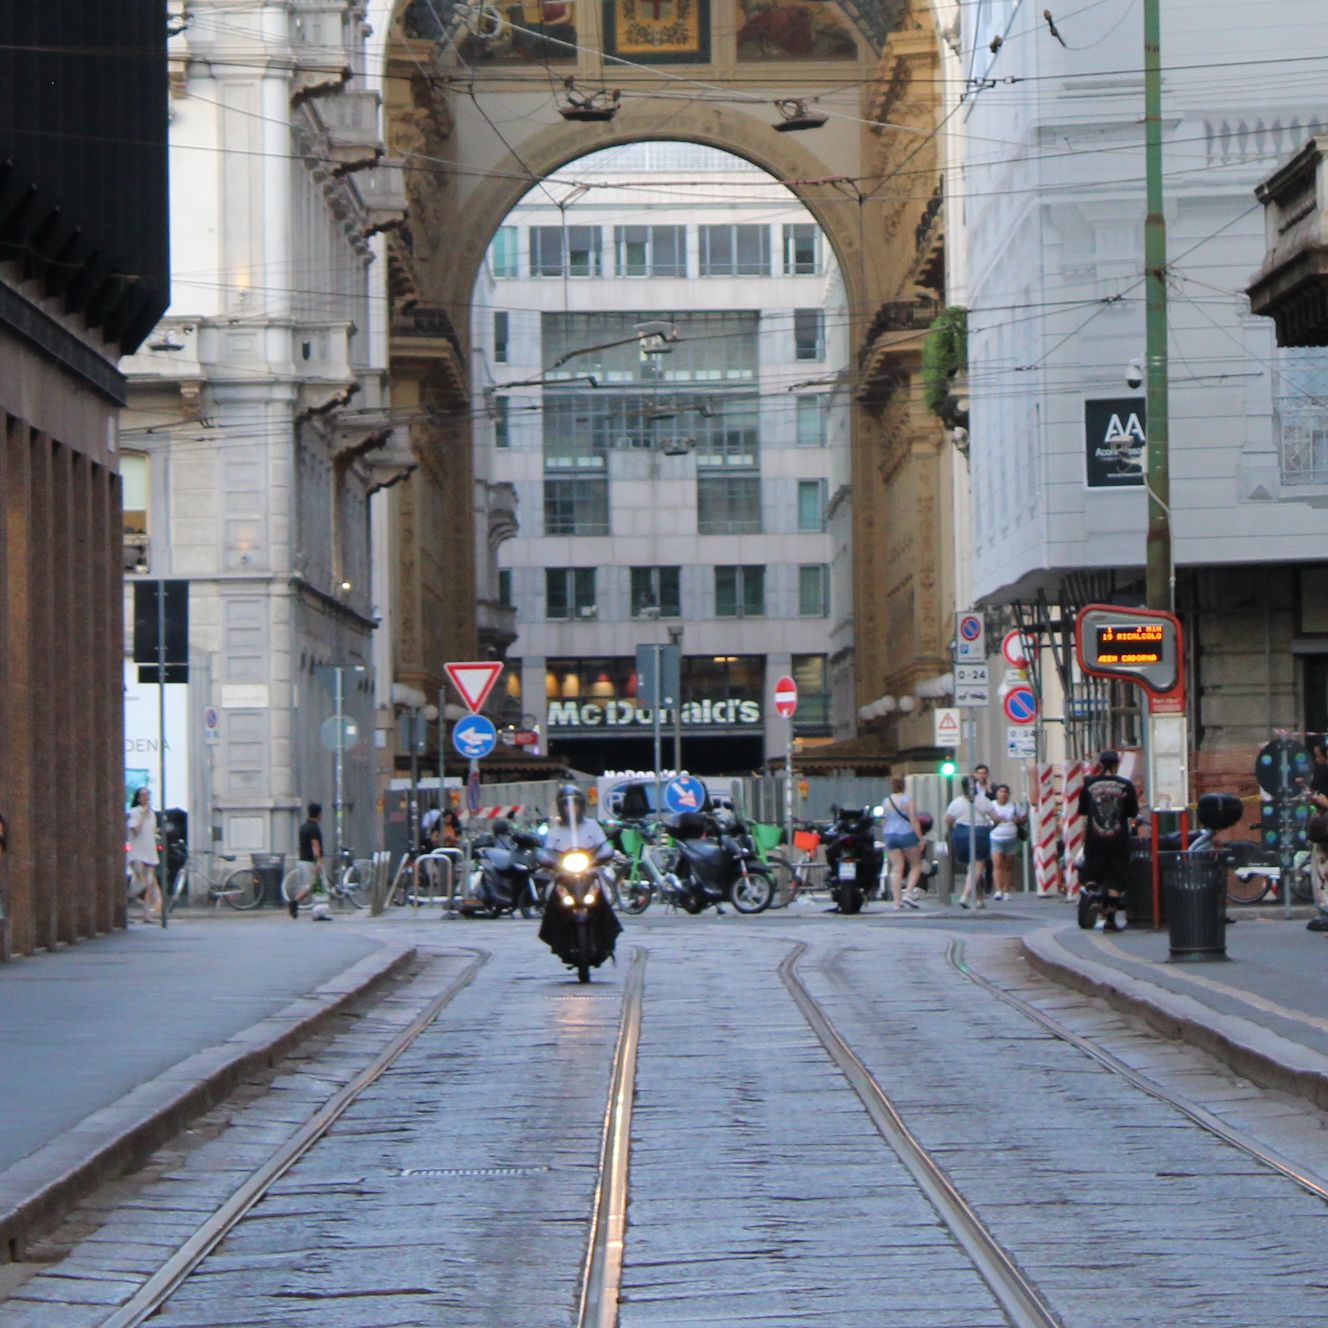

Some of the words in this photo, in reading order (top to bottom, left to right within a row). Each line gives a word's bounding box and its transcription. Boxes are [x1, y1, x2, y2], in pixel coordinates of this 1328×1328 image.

[1102, 633, 1113, 641] 19
[1116, 632, 1163, 641] RICALCOLO
[1121, 654, 1157, 662] CADORNA
[548, 699, 760, 726] McDonald's
